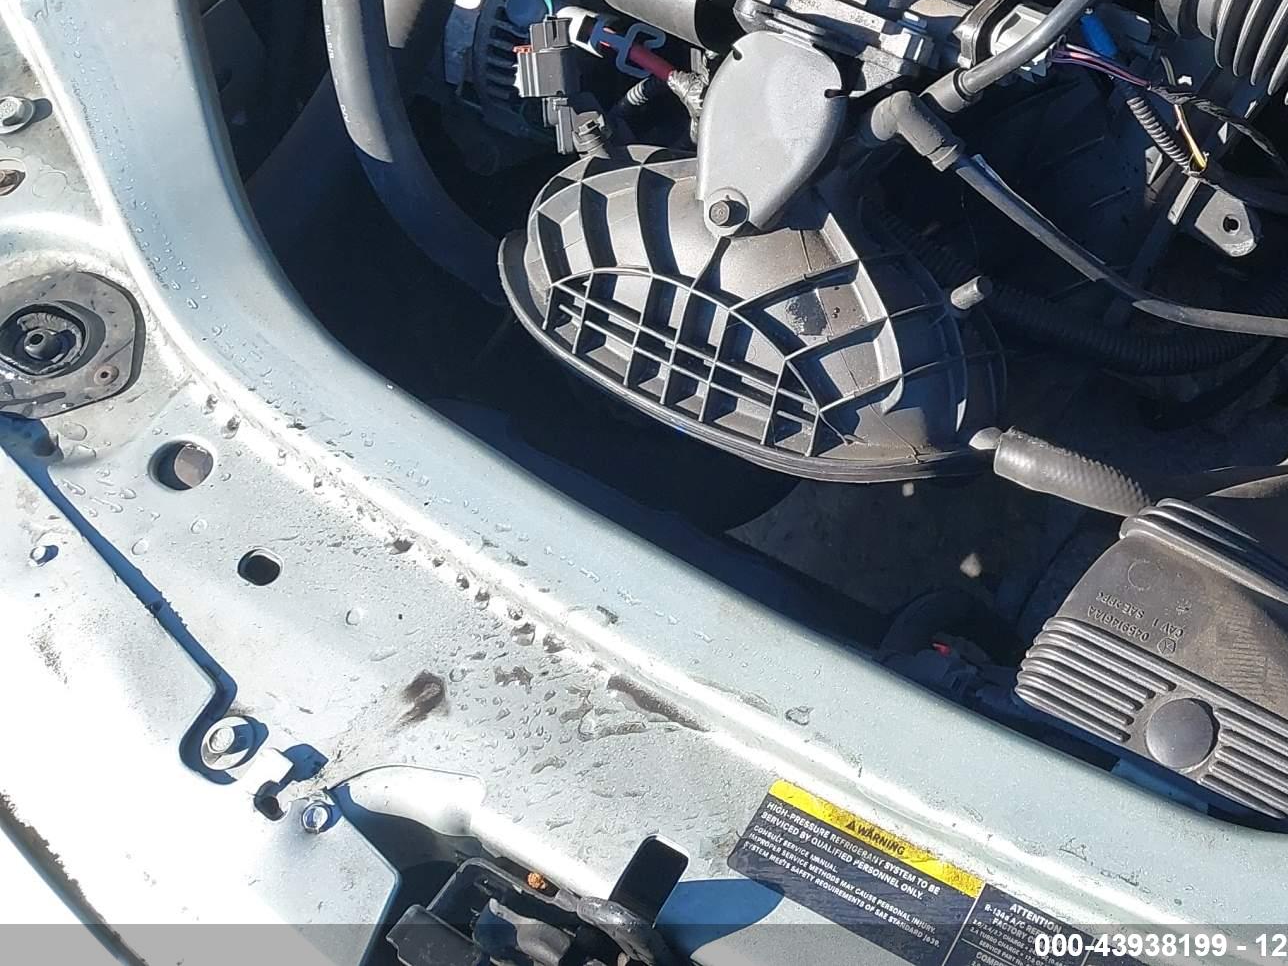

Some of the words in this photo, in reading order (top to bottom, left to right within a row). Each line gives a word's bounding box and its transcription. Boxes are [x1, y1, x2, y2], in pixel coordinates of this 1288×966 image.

[1122, 602, 1145, 619] SAE
[1161, 621, 1184, 638] CAV
[753, 824, 784, 844] CONSULT
[782, 839, 809, 857] SERVICE
[809, 853, 839, 873] MANUAL.
[766, 800, 830, 838] HIGH-PRESSURE
[828, 833, 885, 867] REFRIGERANT
[883, 861, 916, 883] SYSTEM
[915, 877, 928, 889] TO
[927, 883, 940, 895] BE
[856, 824, 906, 855] WARNING
[760, 810, 799, 836] SERVICED
[798, 830, 811, 842] BY
[810, 836, 853, 863] QUALIFIED
[852, 858, 901, 888] PERSONNEL
[899, 882, 924, 900] ONLY.
[742, 840, 769, 859] SYSTEM
[768, 854, 790, 869] MEETS
[789, 864, 815, 882] SAFETY
[813, 877, 865, 908] REQUIREMENTS
[864, 903, 874, 913] OF
[873, 908, 888, 920] SAE
[887, 915, 923, 938] STANDARD
[747, 832, 782, 854] IMPROPER
[780, 849, 808, 868] SERVICE
[808, 863, 840, 884] METHODS
[839, 880, 855, 892] MAY
[854, 887, 877, 903] CAUSE
[876, 899, 911, 921] PERSONAL
[910, 916, 936, 934] INJURY.
[983, 903, 1010, 921] R-134a
[1008, 916, 1026, 930] A/C
[991, 916, 1027, 940] FACTORY
[1009, 902, 1062, 935] ATTENTION
[978, 930, 997, 943] TURBO
[996, 940, 1020, 955] CHARGE
[978, 939, 1001, 955] SERVICE
[1000, 951, 1016, 962] PART
[1002, 933, 1024, 948] CHARGE
